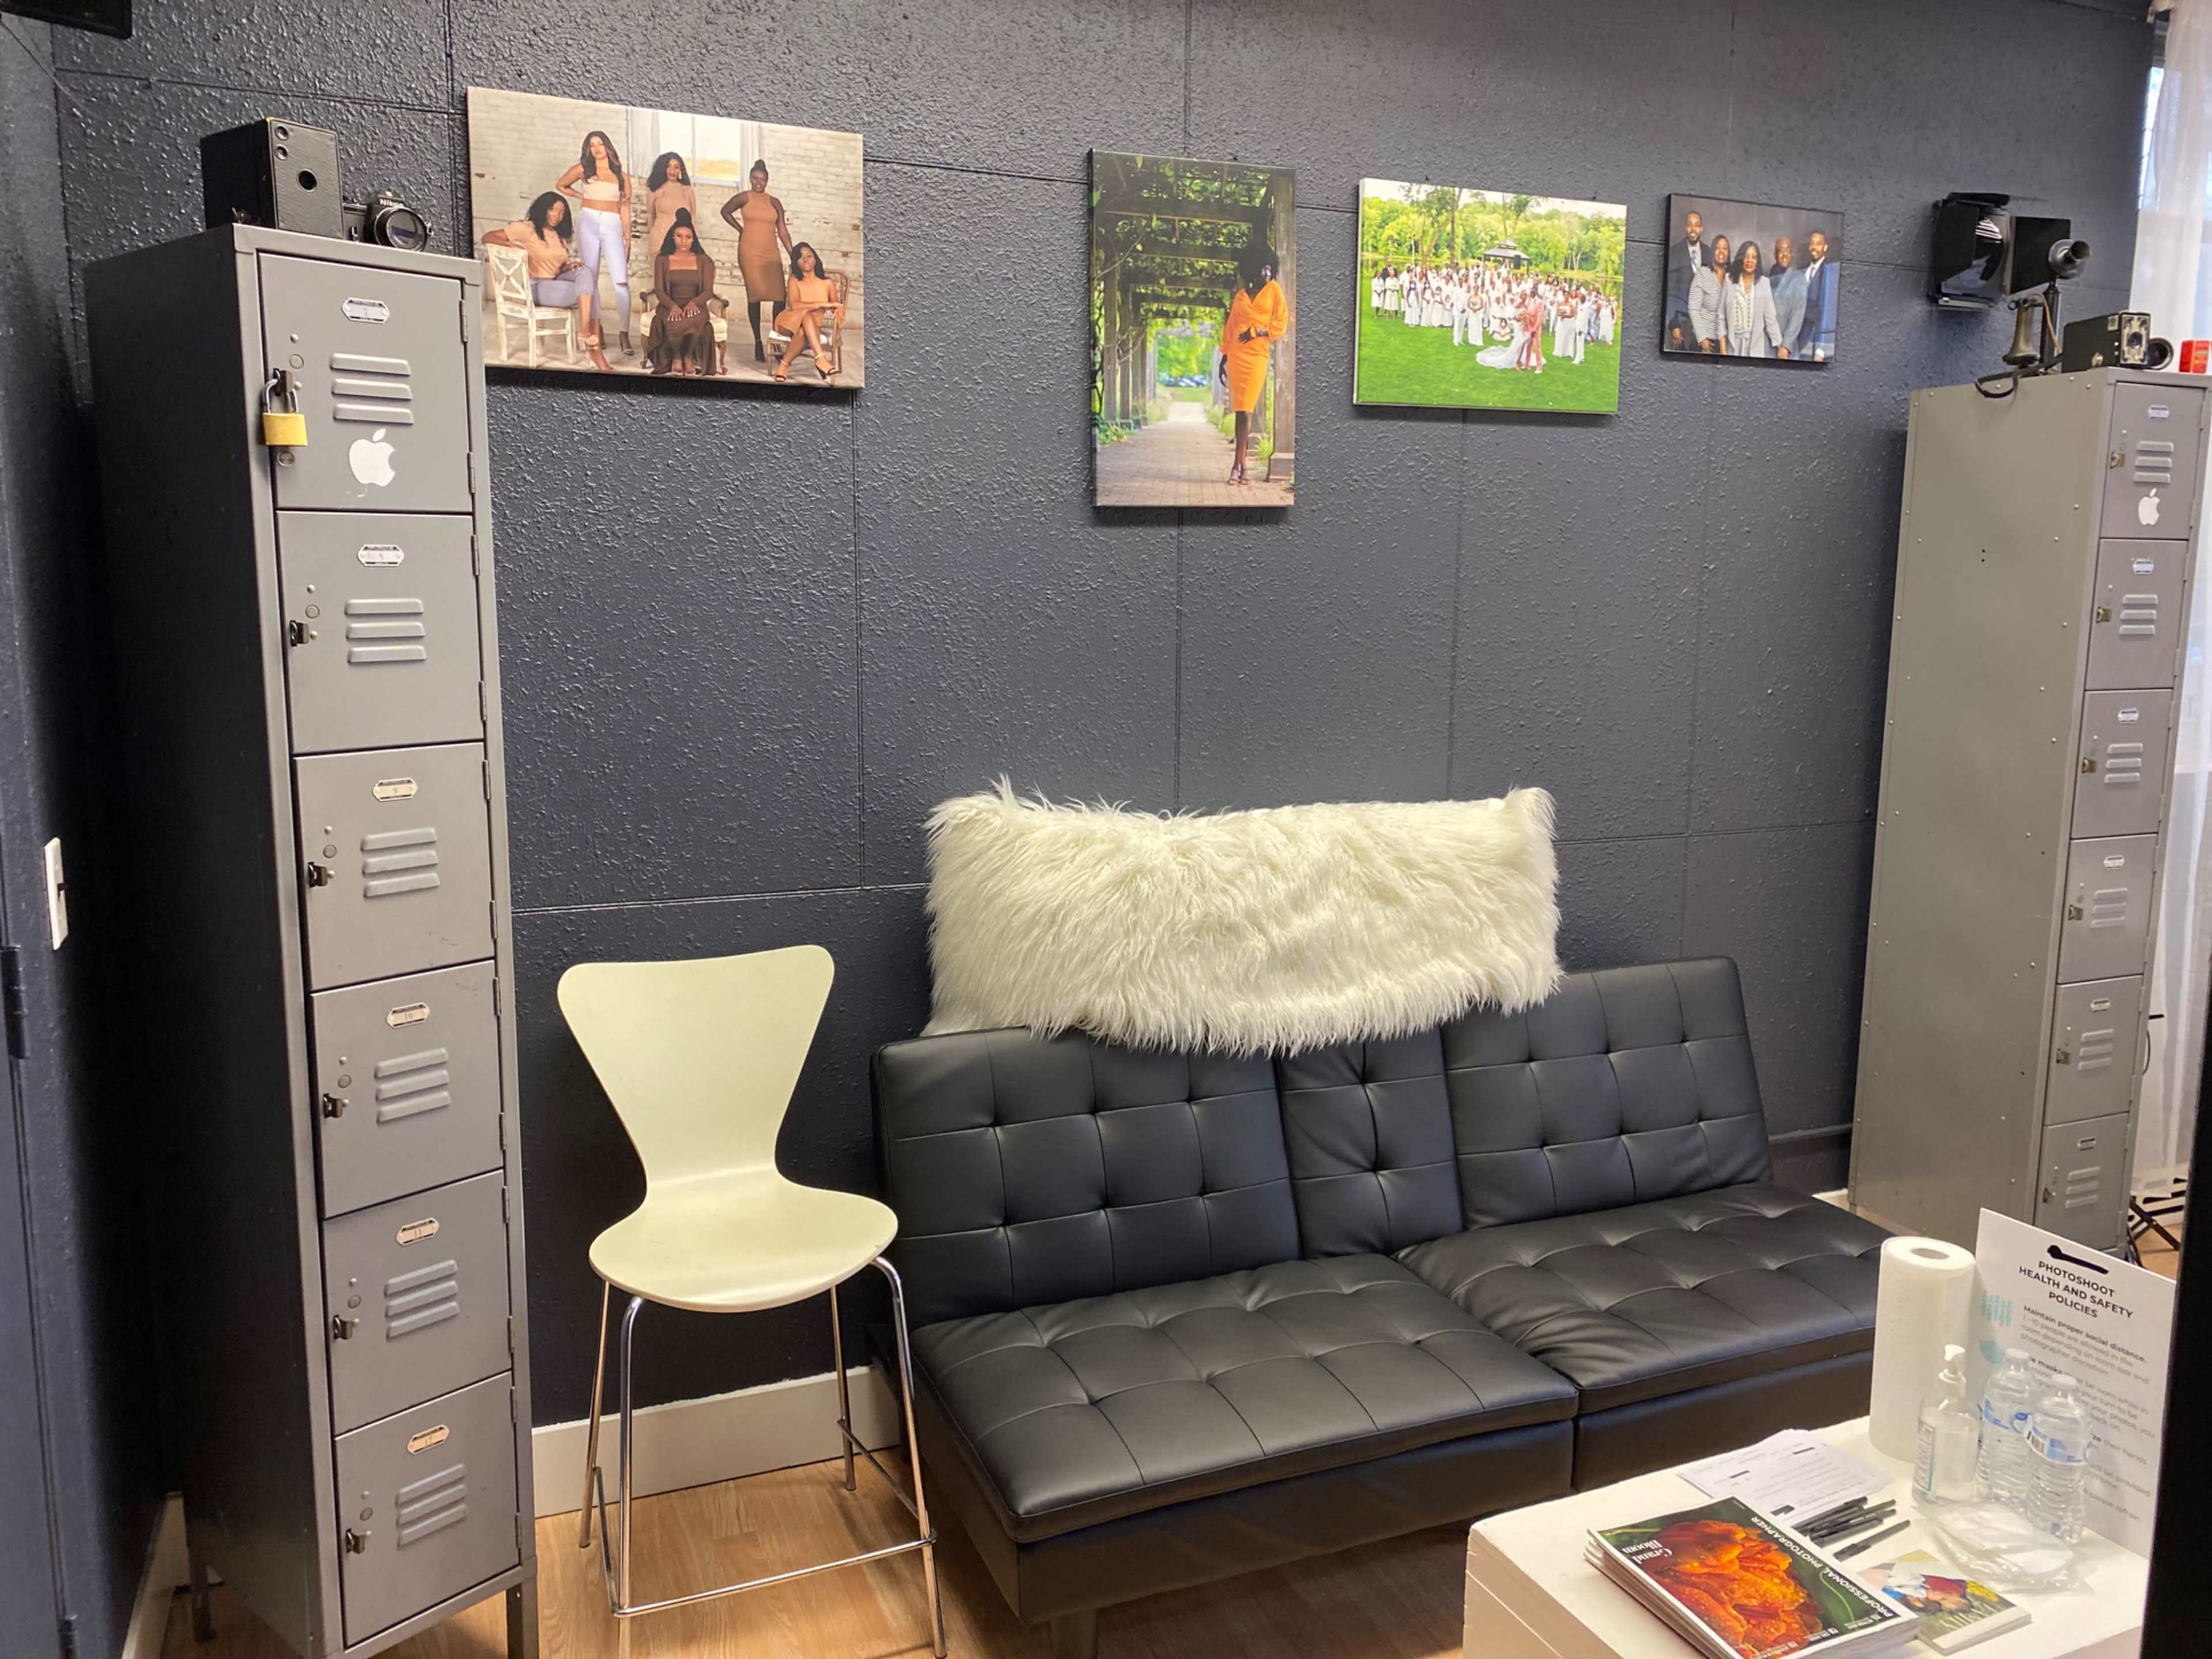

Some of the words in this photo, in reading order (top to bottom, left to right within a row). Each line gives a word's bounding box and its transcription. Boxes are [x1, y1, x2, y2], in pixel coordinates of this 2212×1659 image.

[380, 199, 404, 208] Nikon
[2019, 1266, 2060, 1289] HEALTH
[2063, 1285, 2087, 1300] AND
[2090, 1295, 2133, 1318] SAFETY
[2039, 1261, 2115, 1297] PHOTOSHOOT
[2049, 1291, 2098, 1317] POLICIES
[2020, 1332, 2070, 1359] photographer
[2024, 1305, 2056, 1323] Maintain
[2058, 1321, 2084, 1335] proper
[2085, 1332, 2108, 1346] social
[2110, 1342, 2146, 1363] distance.
[2037, 1359, 2063, 1374] masks
[2043, 1332, 2082, 1356] depending
[2094, 1355, 2116, 1370] room
[1622, 1539, 1663, 1554] Bloom
[1632, 1548, 1673, 1565] Grand
[1751, 1516, 1823, 1569] PHOTOGRAPHER
[1824, 1567, 1893, 1618] PROFESSIONAL
